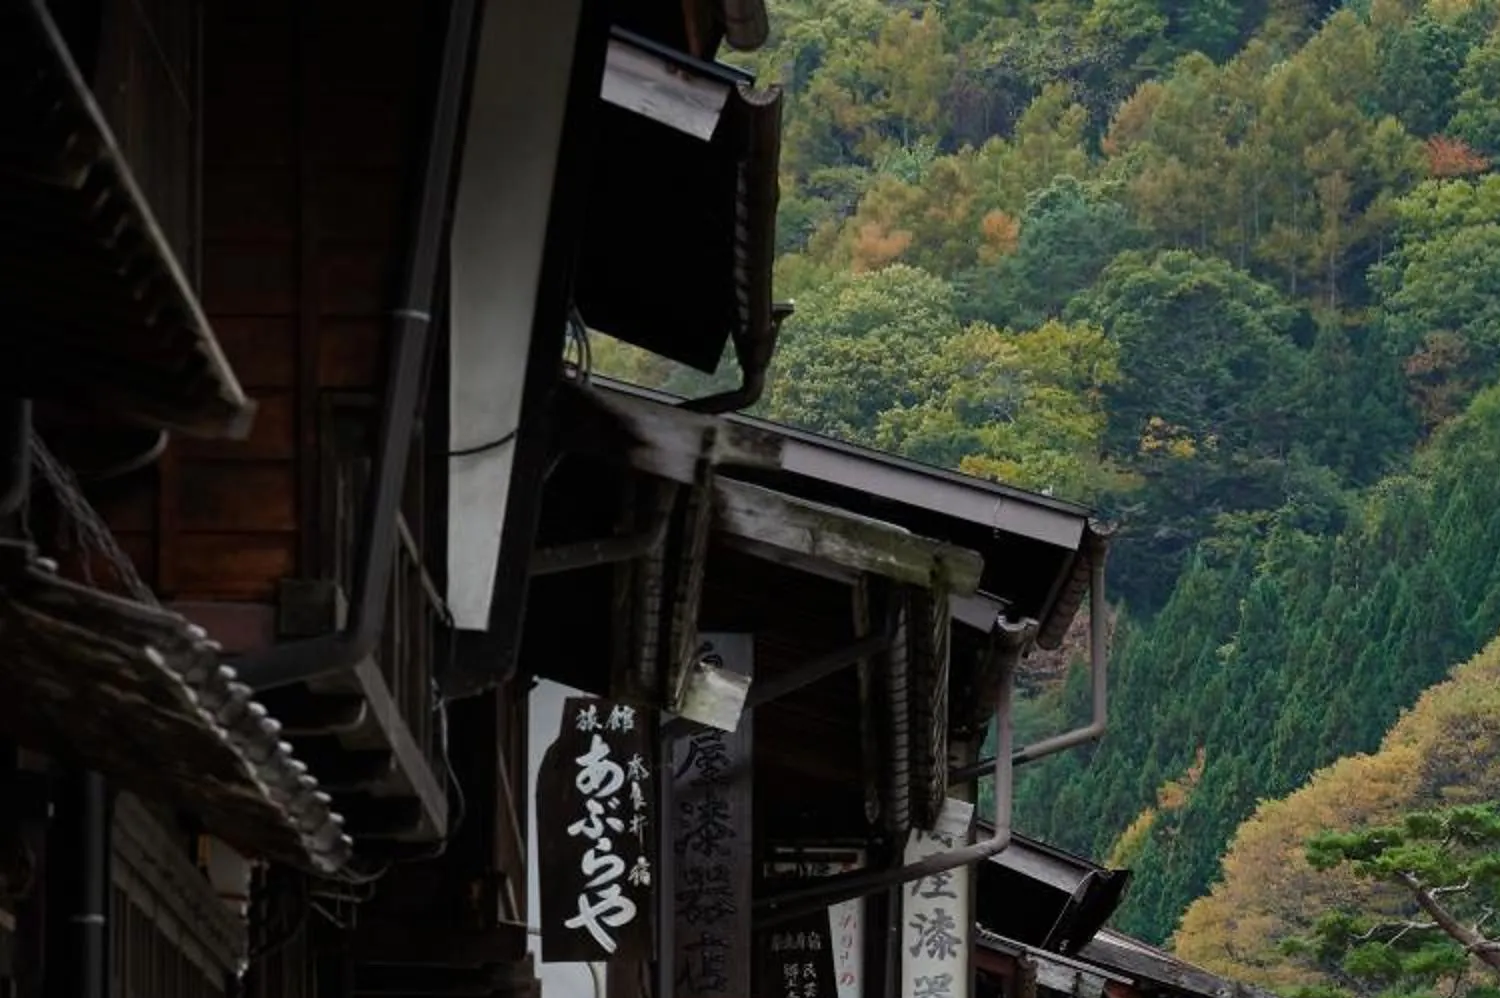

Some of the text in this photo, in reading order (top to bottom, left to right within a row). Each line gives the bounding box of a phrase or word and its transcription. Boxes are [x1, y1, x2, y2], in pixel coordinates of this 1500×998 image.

[576, 703, 636, 732] 旅館
[564, 733, 638, 955] あぶらや
[627, 752, 652, 888] 奈良井宿
